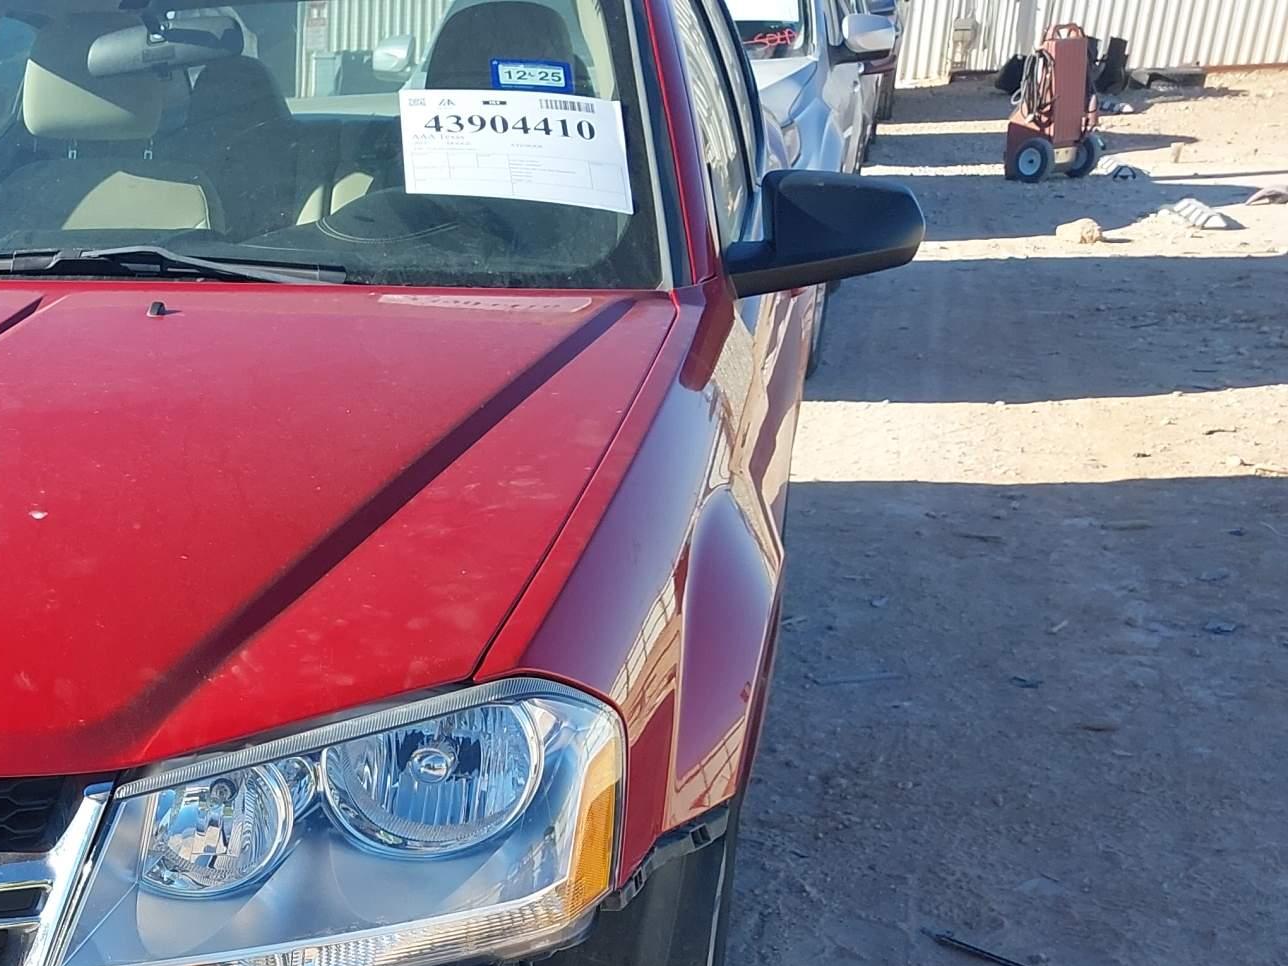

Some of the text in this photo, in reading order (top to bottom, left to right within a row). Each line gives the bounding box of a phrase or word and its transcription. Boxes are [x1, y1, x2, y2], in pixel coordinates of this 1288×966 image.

[503, 70, 562, 82] 12 25
[423, 114, 595, 141] 43904410
